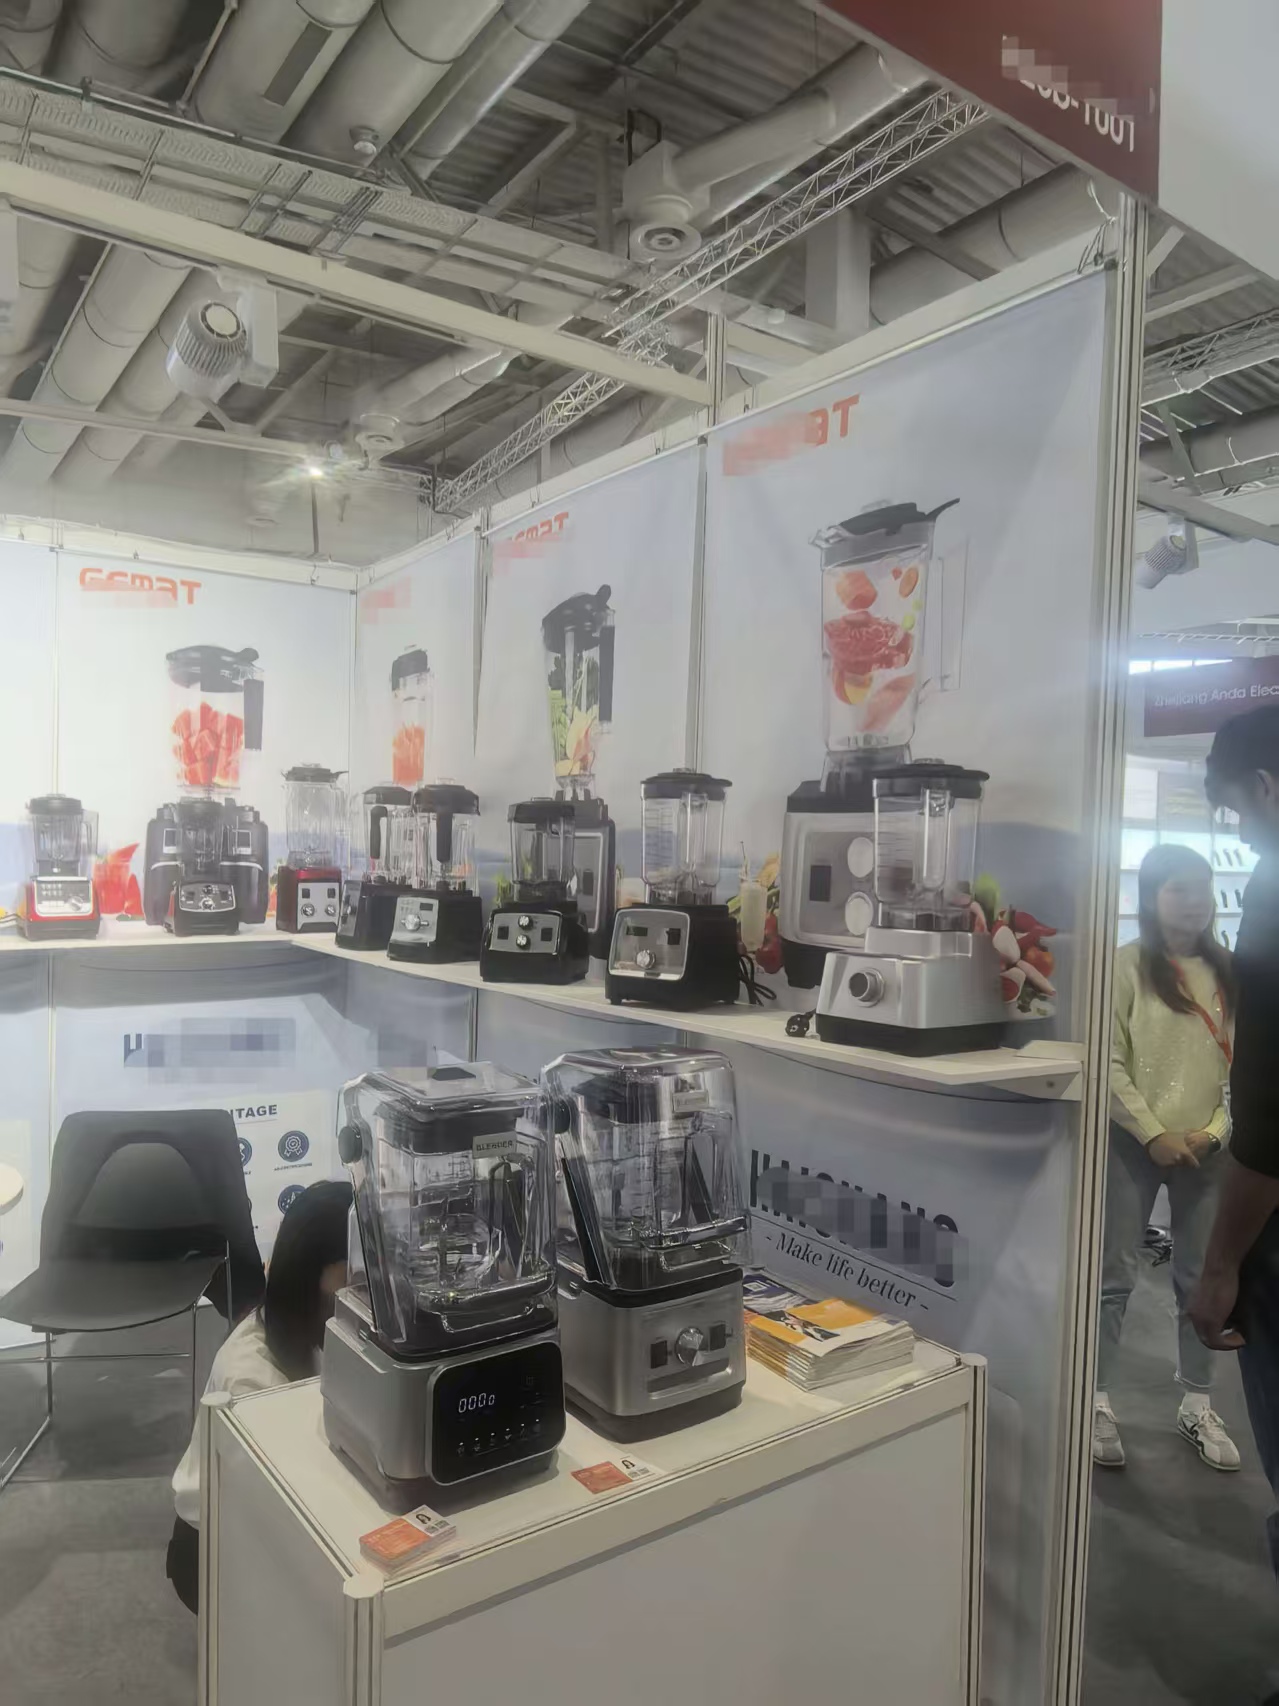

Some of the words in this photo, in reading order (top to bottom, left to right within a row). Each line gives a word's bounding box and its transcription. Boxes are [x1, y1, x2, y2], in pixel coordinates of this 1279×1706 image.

[1211, 687, 1246, 701] Anda
[230, 1104, 278, 1119] TAGE
[775, 1232, 823, 1267] Make
[826, 1254, 855, 1281] life
[857, 1268, 917, 1310] better
